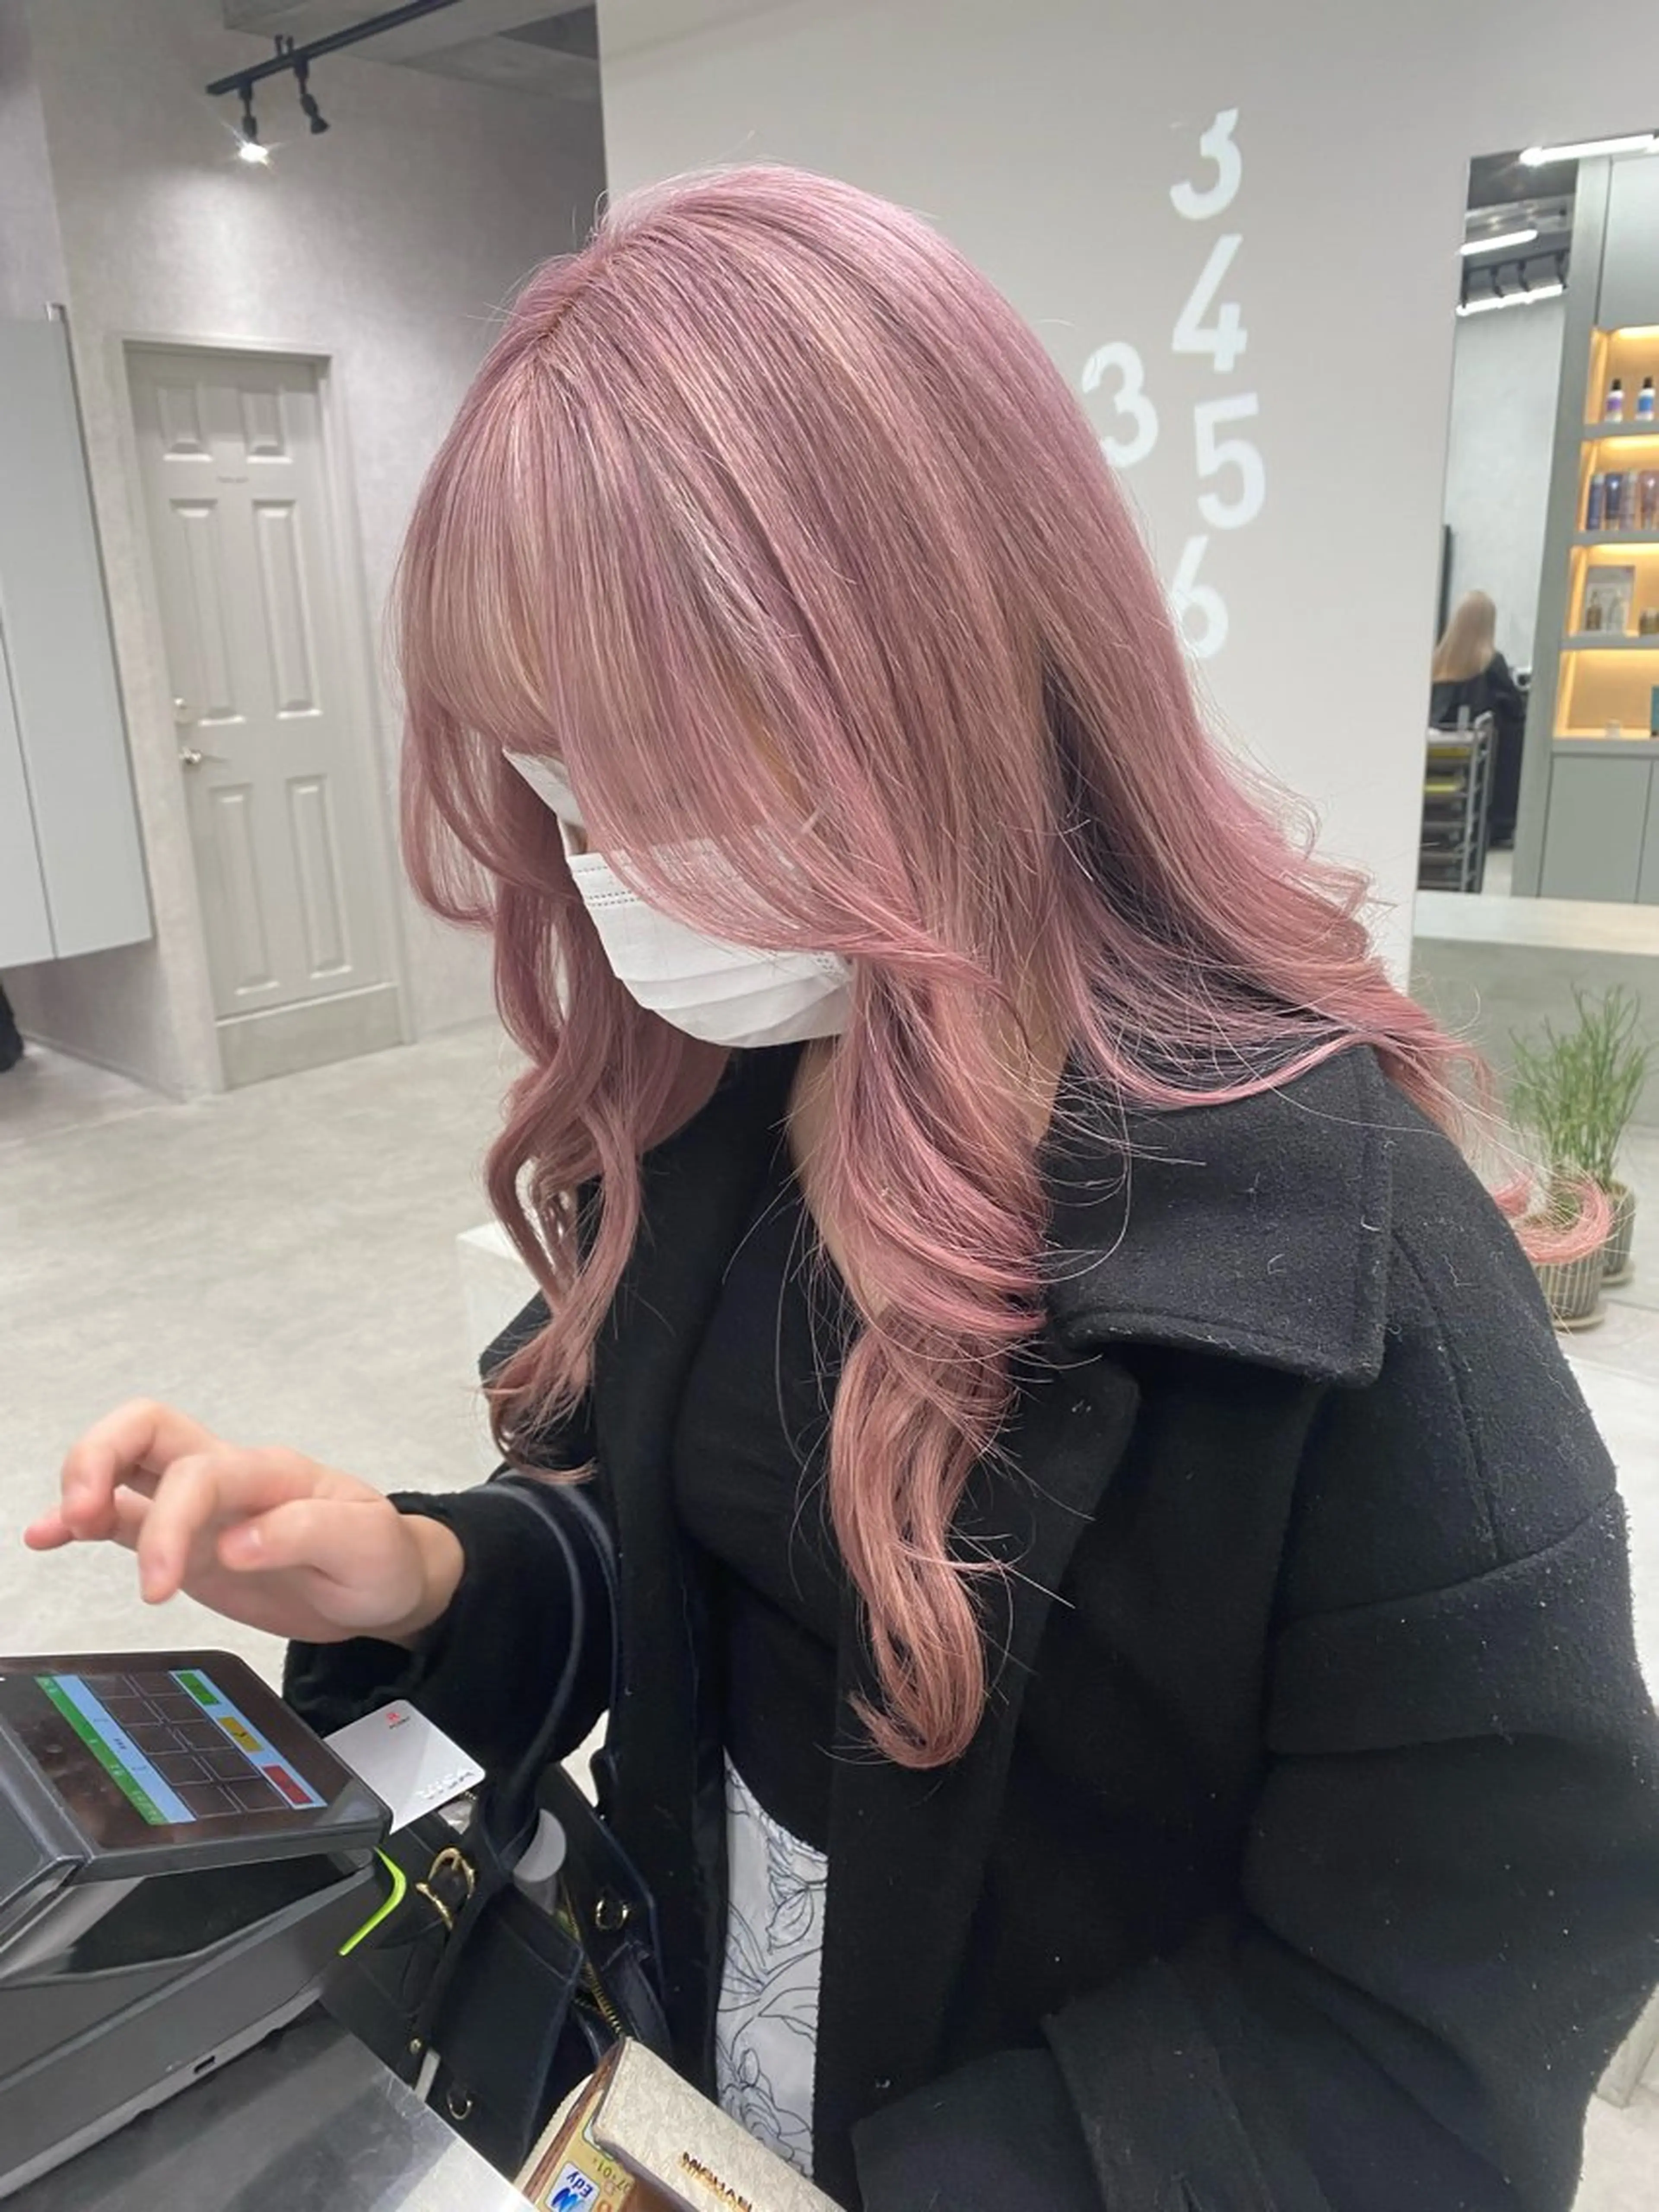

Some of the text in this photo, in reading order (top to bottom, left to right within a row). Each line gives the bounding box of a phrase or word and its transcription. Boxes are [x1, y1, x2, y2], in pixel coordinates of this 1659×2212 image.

[1171, 233, 1248, 374] 4
[1082, 341, 1159, 468] 3
[1194, 392, 1265, 530] 5
[1172, 534, 1229, 658] 6
[566, 2171, 594, 2198] Edy
